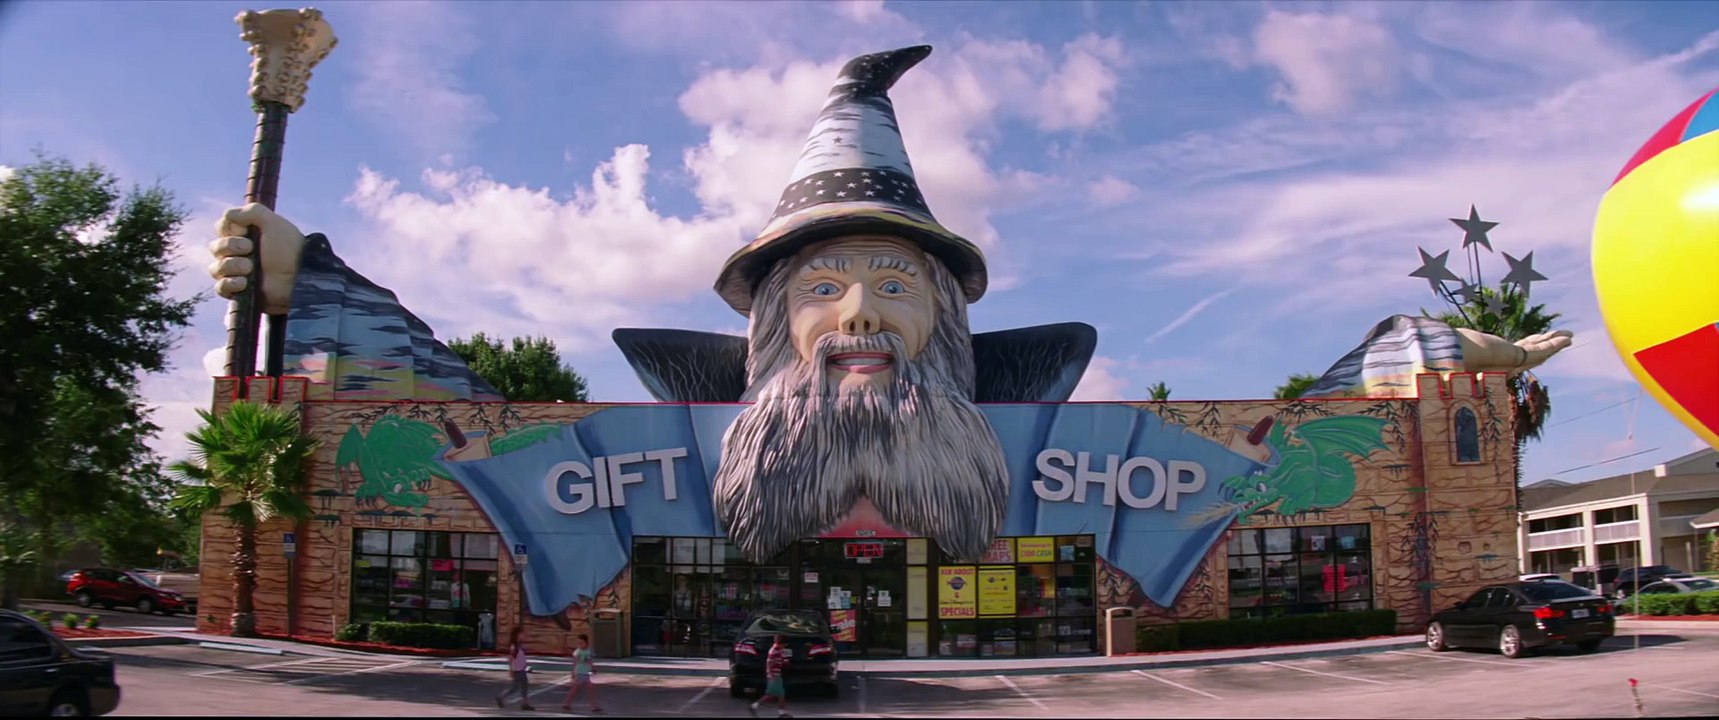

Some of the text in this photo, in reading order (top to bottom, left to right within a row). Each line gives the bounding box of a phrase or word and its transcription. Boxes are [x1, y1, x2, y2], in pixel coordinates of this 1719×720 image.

[545, 447, 1206, 515] GIFT SHOP
[846, 544, 883, 557] OPEN
[940, 607, 975, 616] SPECIALS
